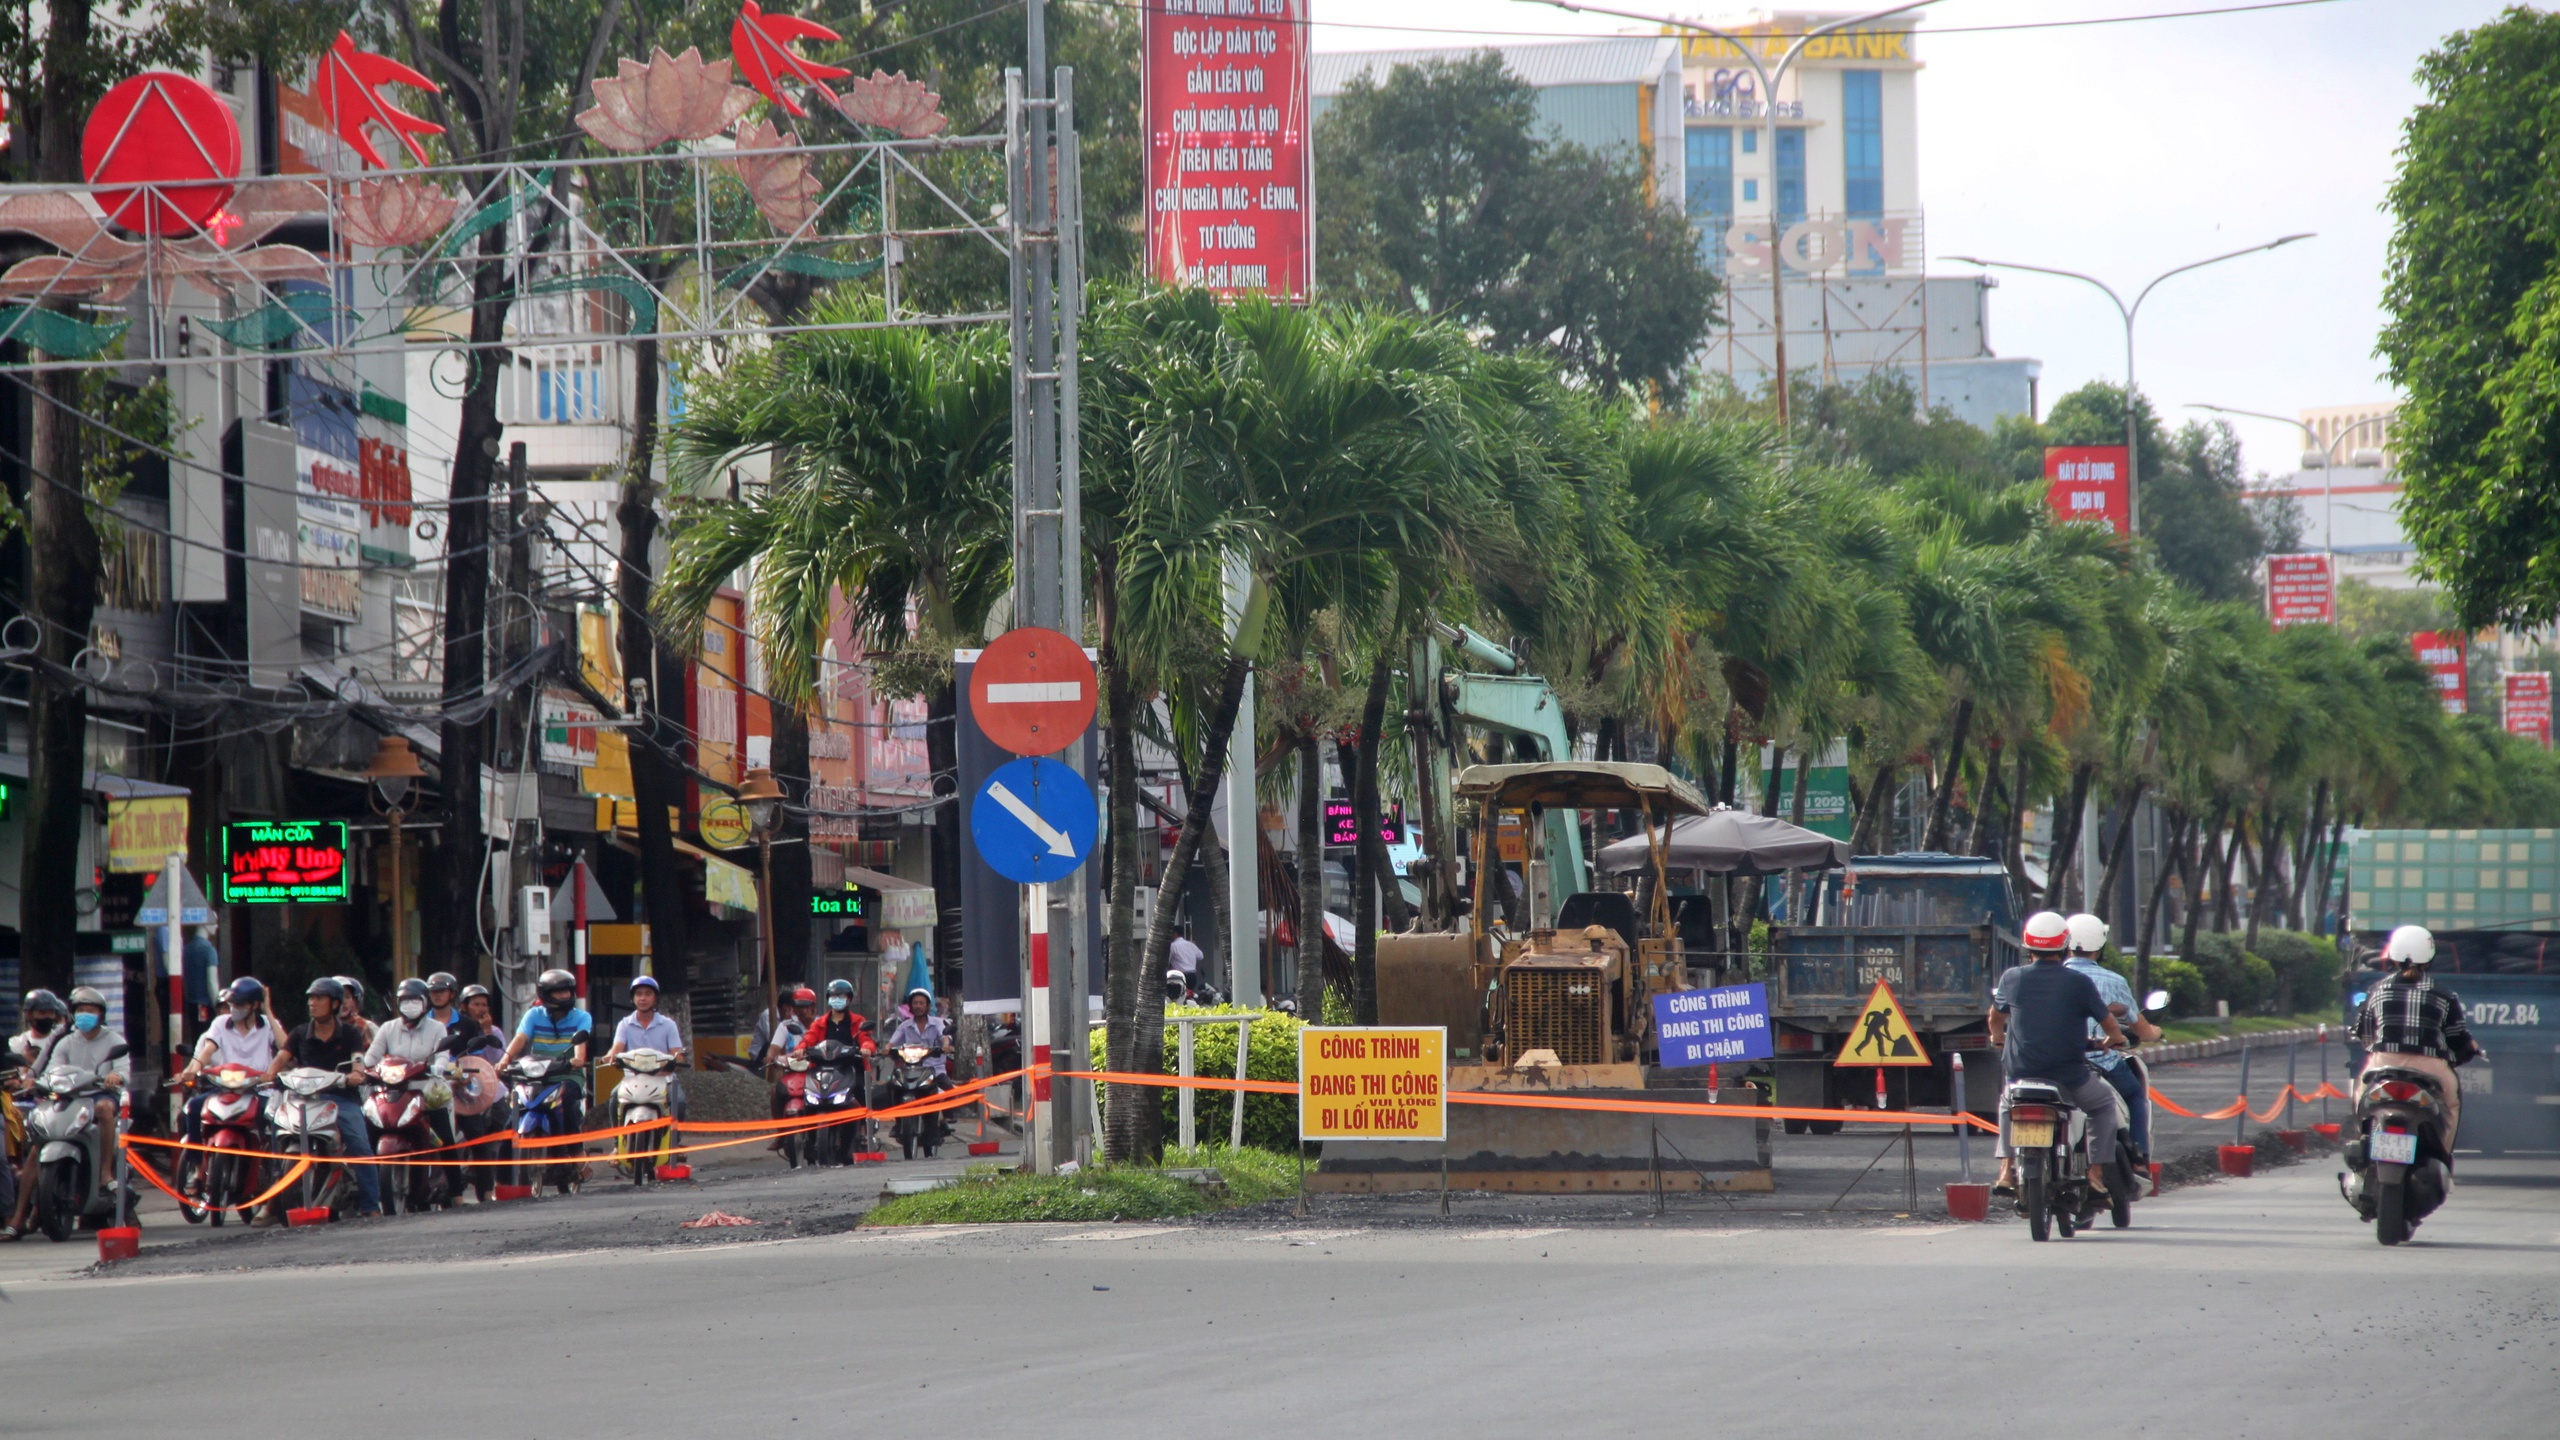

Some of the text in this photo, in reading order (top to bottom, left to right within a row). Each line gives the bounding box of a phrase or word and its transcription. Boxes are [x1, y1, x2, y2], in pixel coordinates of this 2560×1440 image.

[1173, 25, 1276, 60] ĐỘC LẬP DÂN TỘC
[1802, 27, 1909, 60] BANK
[1188, 61, 1212, 93] GẮN
[1244, 64, 1264, 93] VỚI
[1173, 102, 1279, 136] CHỦ NGHĨA XÃ HỘI
[1180, 144, 1210, 171] TRÊN
[1242, 141, 1272, 171] TẢNG
[1155, 181, 1179, 211] CHỦ
[1182, 183, 1218, 211] NGHĨA
[1222, 182, 1248, 210] MÁC
[1260, 182, 1299, 213] LÊNIN,
[1199, 218, 1256, 249] TƯ TƯỞNG
[1189, 258, 1205, 288] HỒ
[1208, 260, 1228, 288] CHÍ
[2077, 456, 2091, 480] SỬ
[2091, 462, 2115, 484] DỤNG
[2071, 491, 2105, 513] DỊCH VỤ
[1670, 990, 1751, 1014] CÔNG TRÌNH
[1662, 1013, 1764, 1038] ĐANG THI CÔNG
[1320, 1034, 1420, 1059] CÔNG TRÌNH
[1687, 1039, 1745, 1060] ĐI CHẬM
[1310, 1070, 1437, 1096] ĐANG THI CÔNG
[1322, 1101, 1419, 1129] ĐI LỐI KHÁC
[1369, 1096, 1437, 1108] VUI LÒNG
